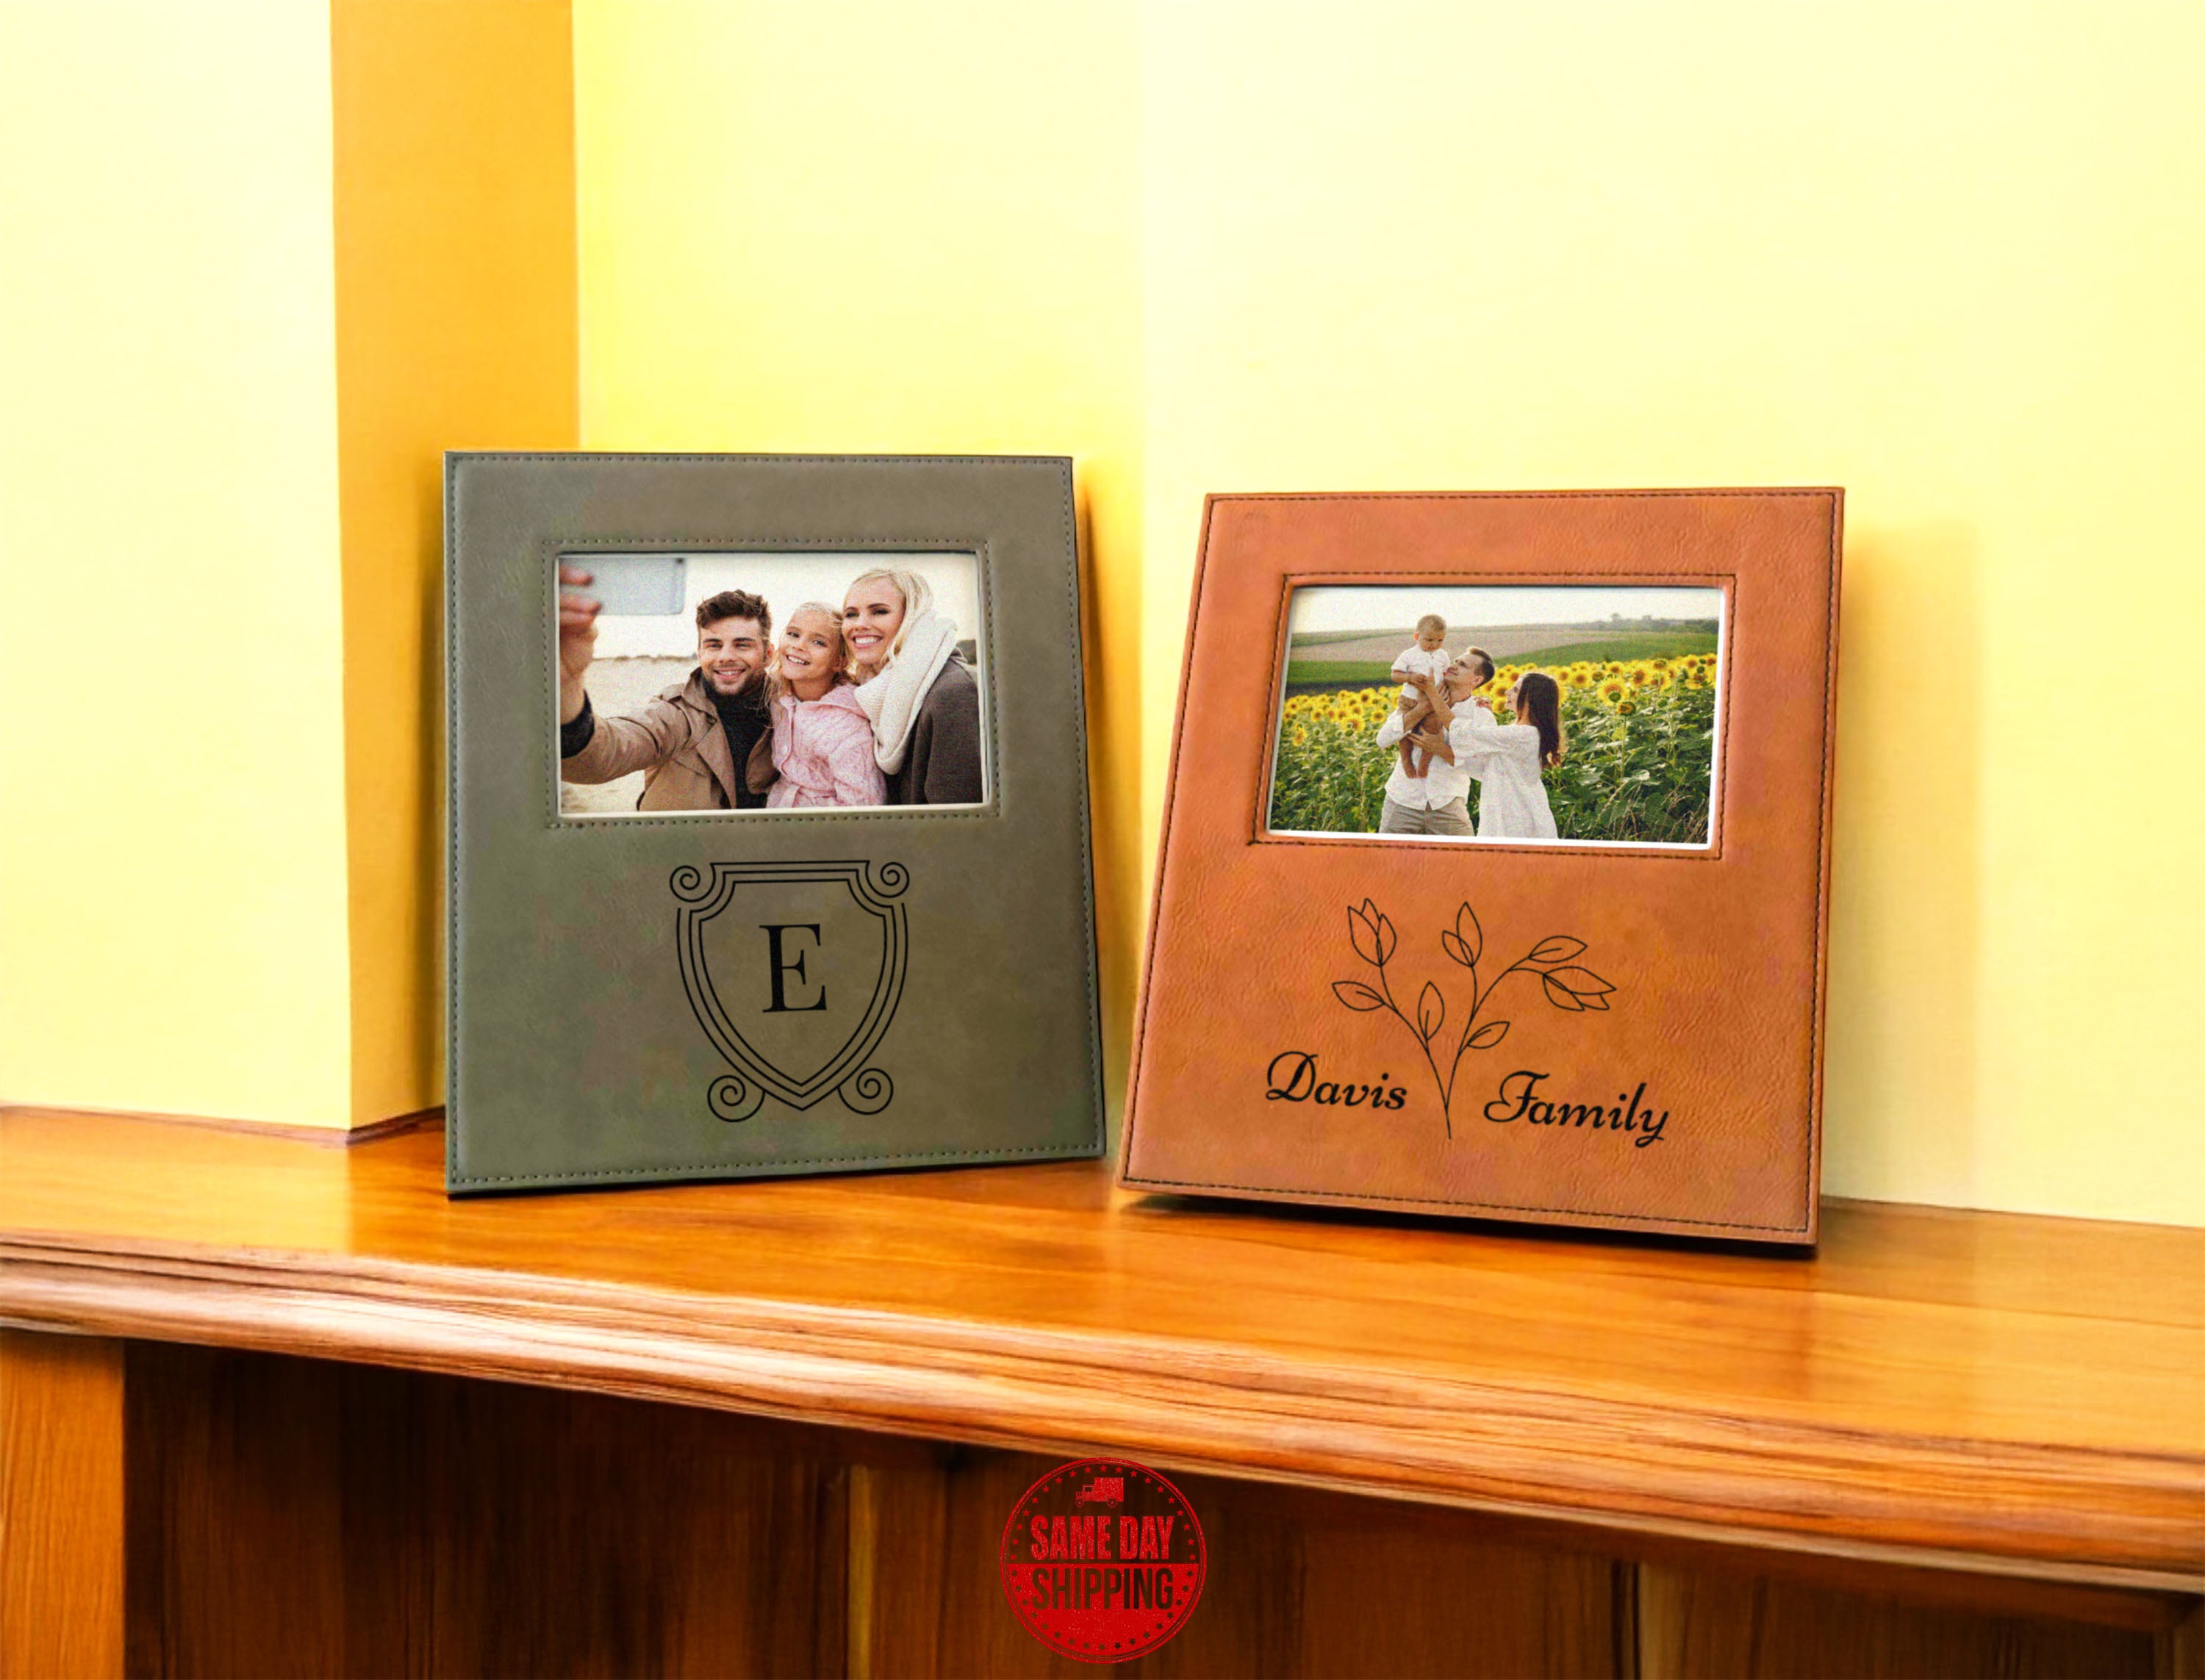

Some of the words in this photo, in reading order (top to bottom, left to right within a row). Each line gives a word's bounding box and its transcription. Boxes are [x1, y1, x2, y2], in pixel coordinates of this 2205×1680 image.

[759, 924, 827, 1013] E
[1265, 1051, 1408, 1110] Davis
[1483, 1070, 1669, 1148] Family
